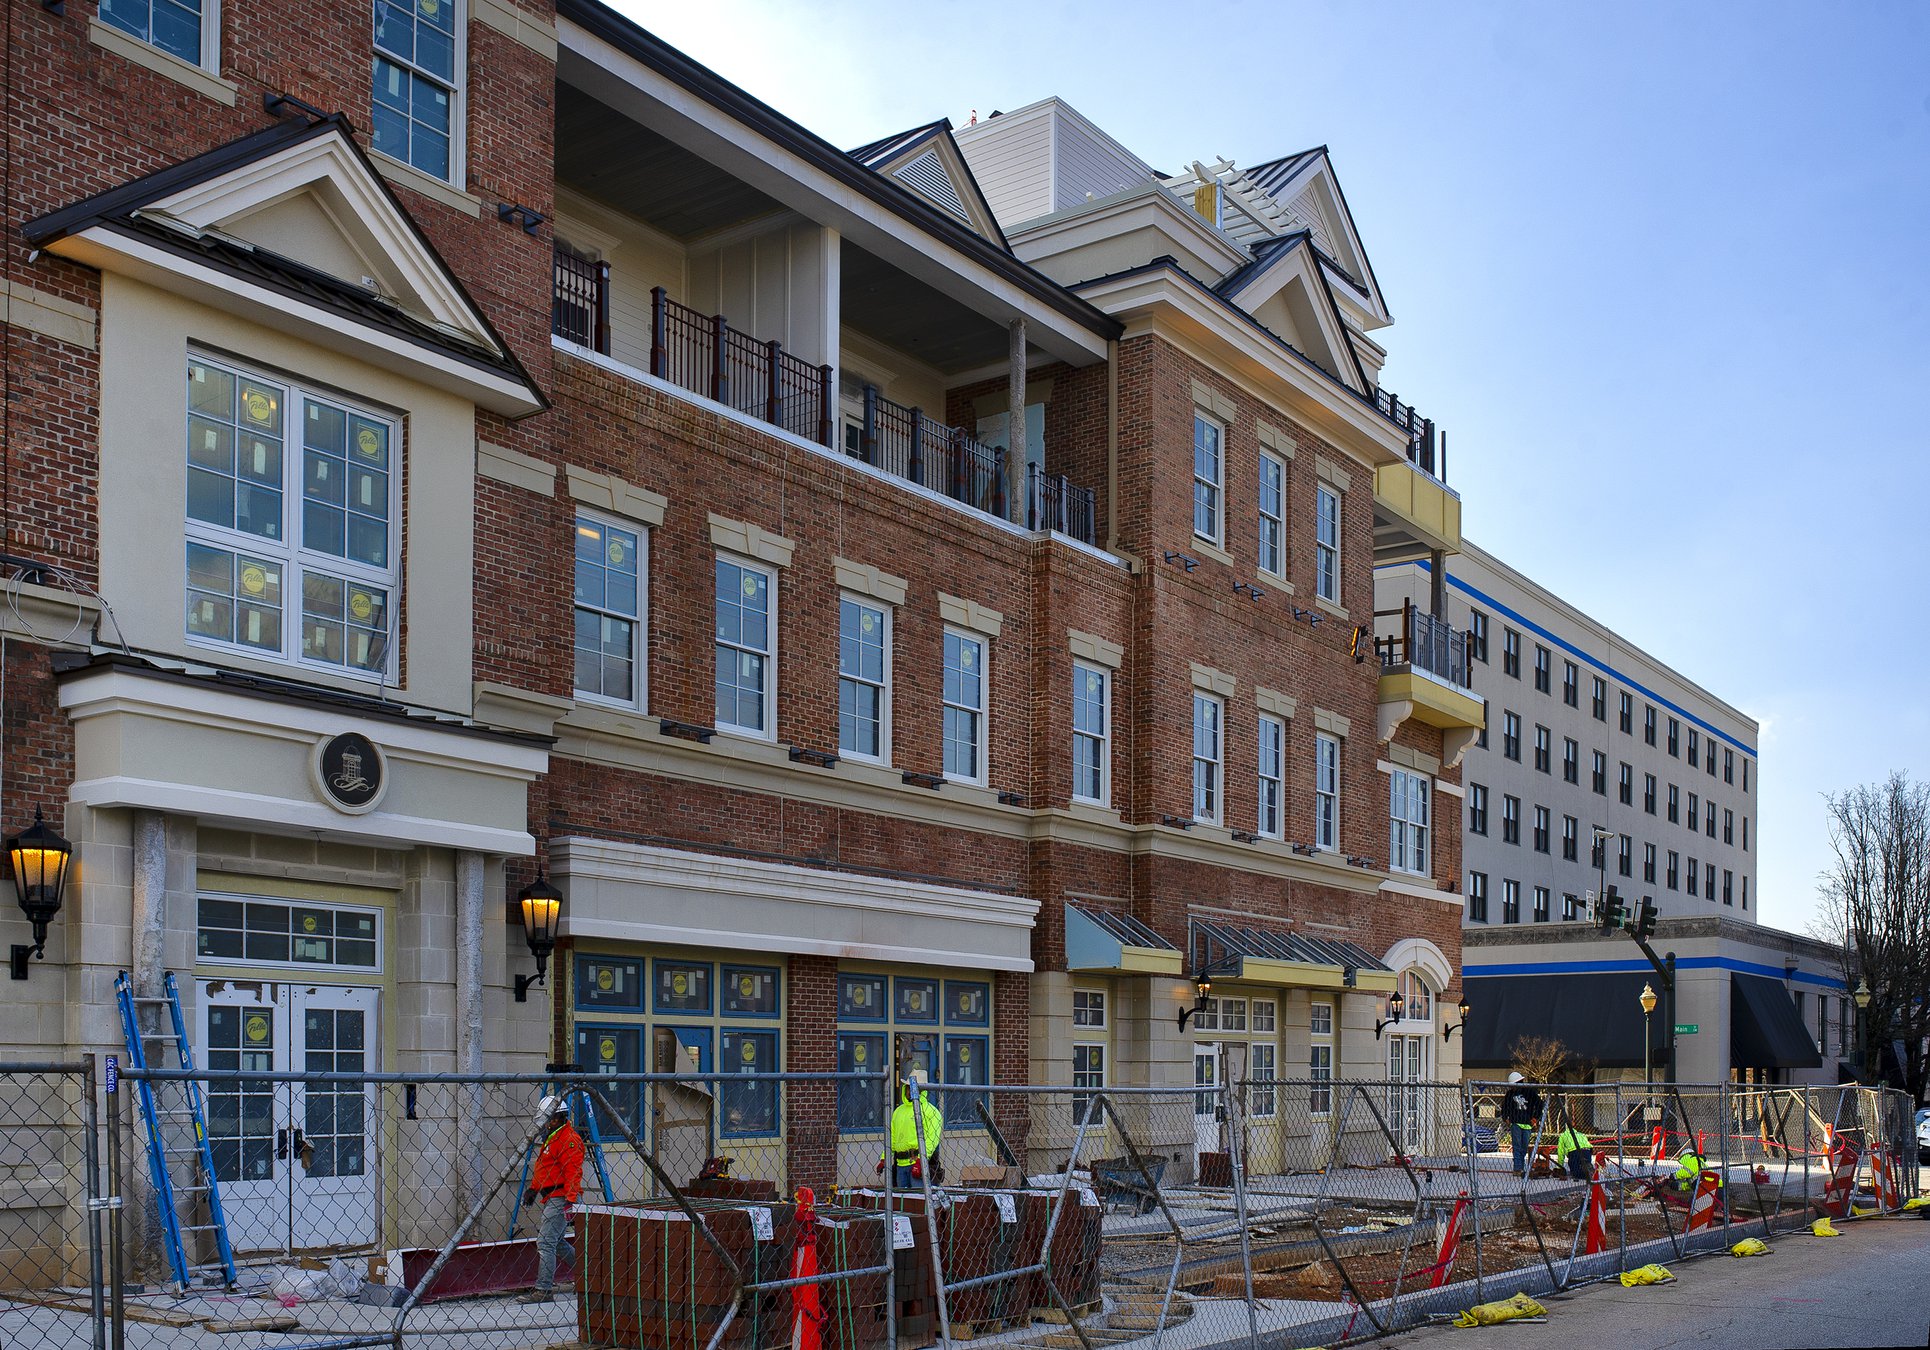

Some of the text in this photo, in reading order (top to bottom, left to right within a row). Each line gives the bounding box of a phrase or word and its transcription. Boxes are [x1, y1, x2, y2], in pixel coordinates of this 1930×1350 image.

[250, 401, 268, 411] Pella
[360, 436, 376, 445] Pella
[245, 573, 263, 582] Pella
[353, 599, 369, 608] Pella
[248, 1022, 266, 1033] Pella
